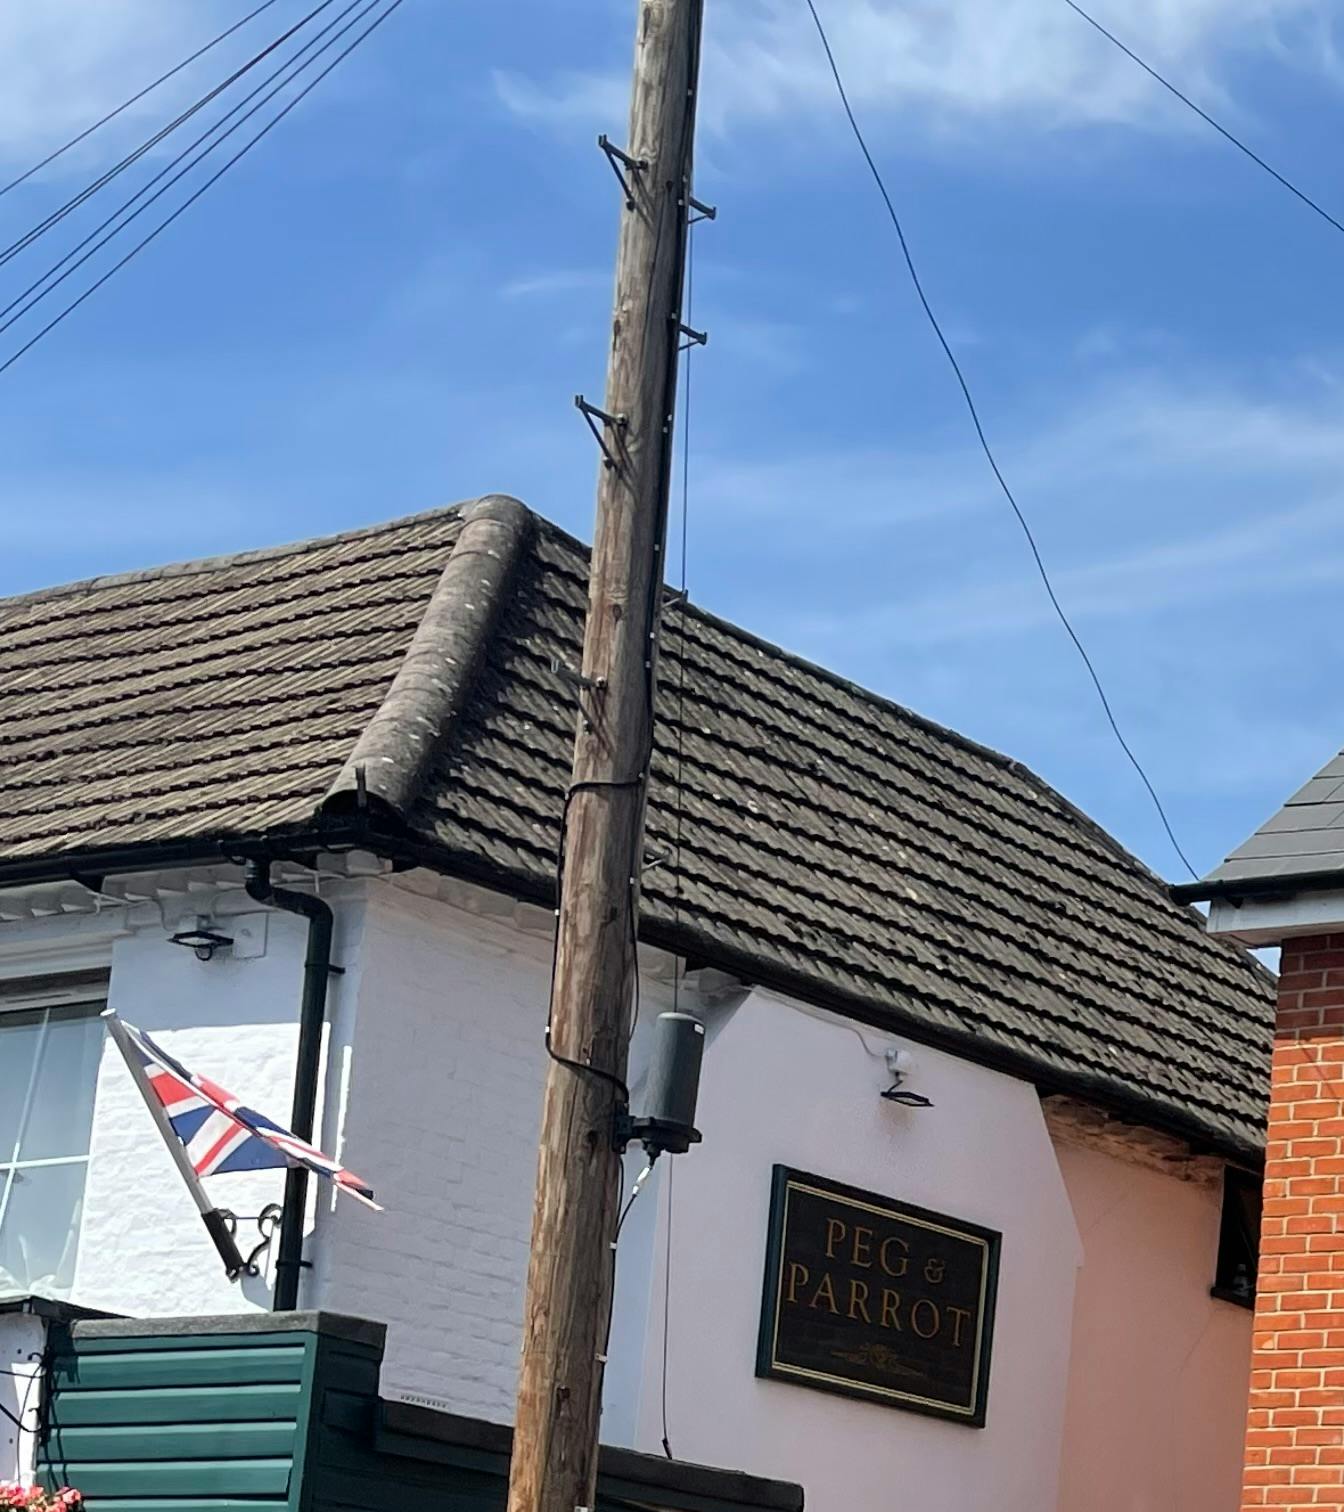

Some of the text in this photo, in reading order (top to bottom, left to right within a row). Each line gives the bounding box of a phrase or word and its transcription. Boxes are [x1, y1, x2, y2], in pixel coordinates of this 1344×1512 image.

[825, 1217, 946, 1284] PEG &
[787, 1261, 971, 1347] PARROT
